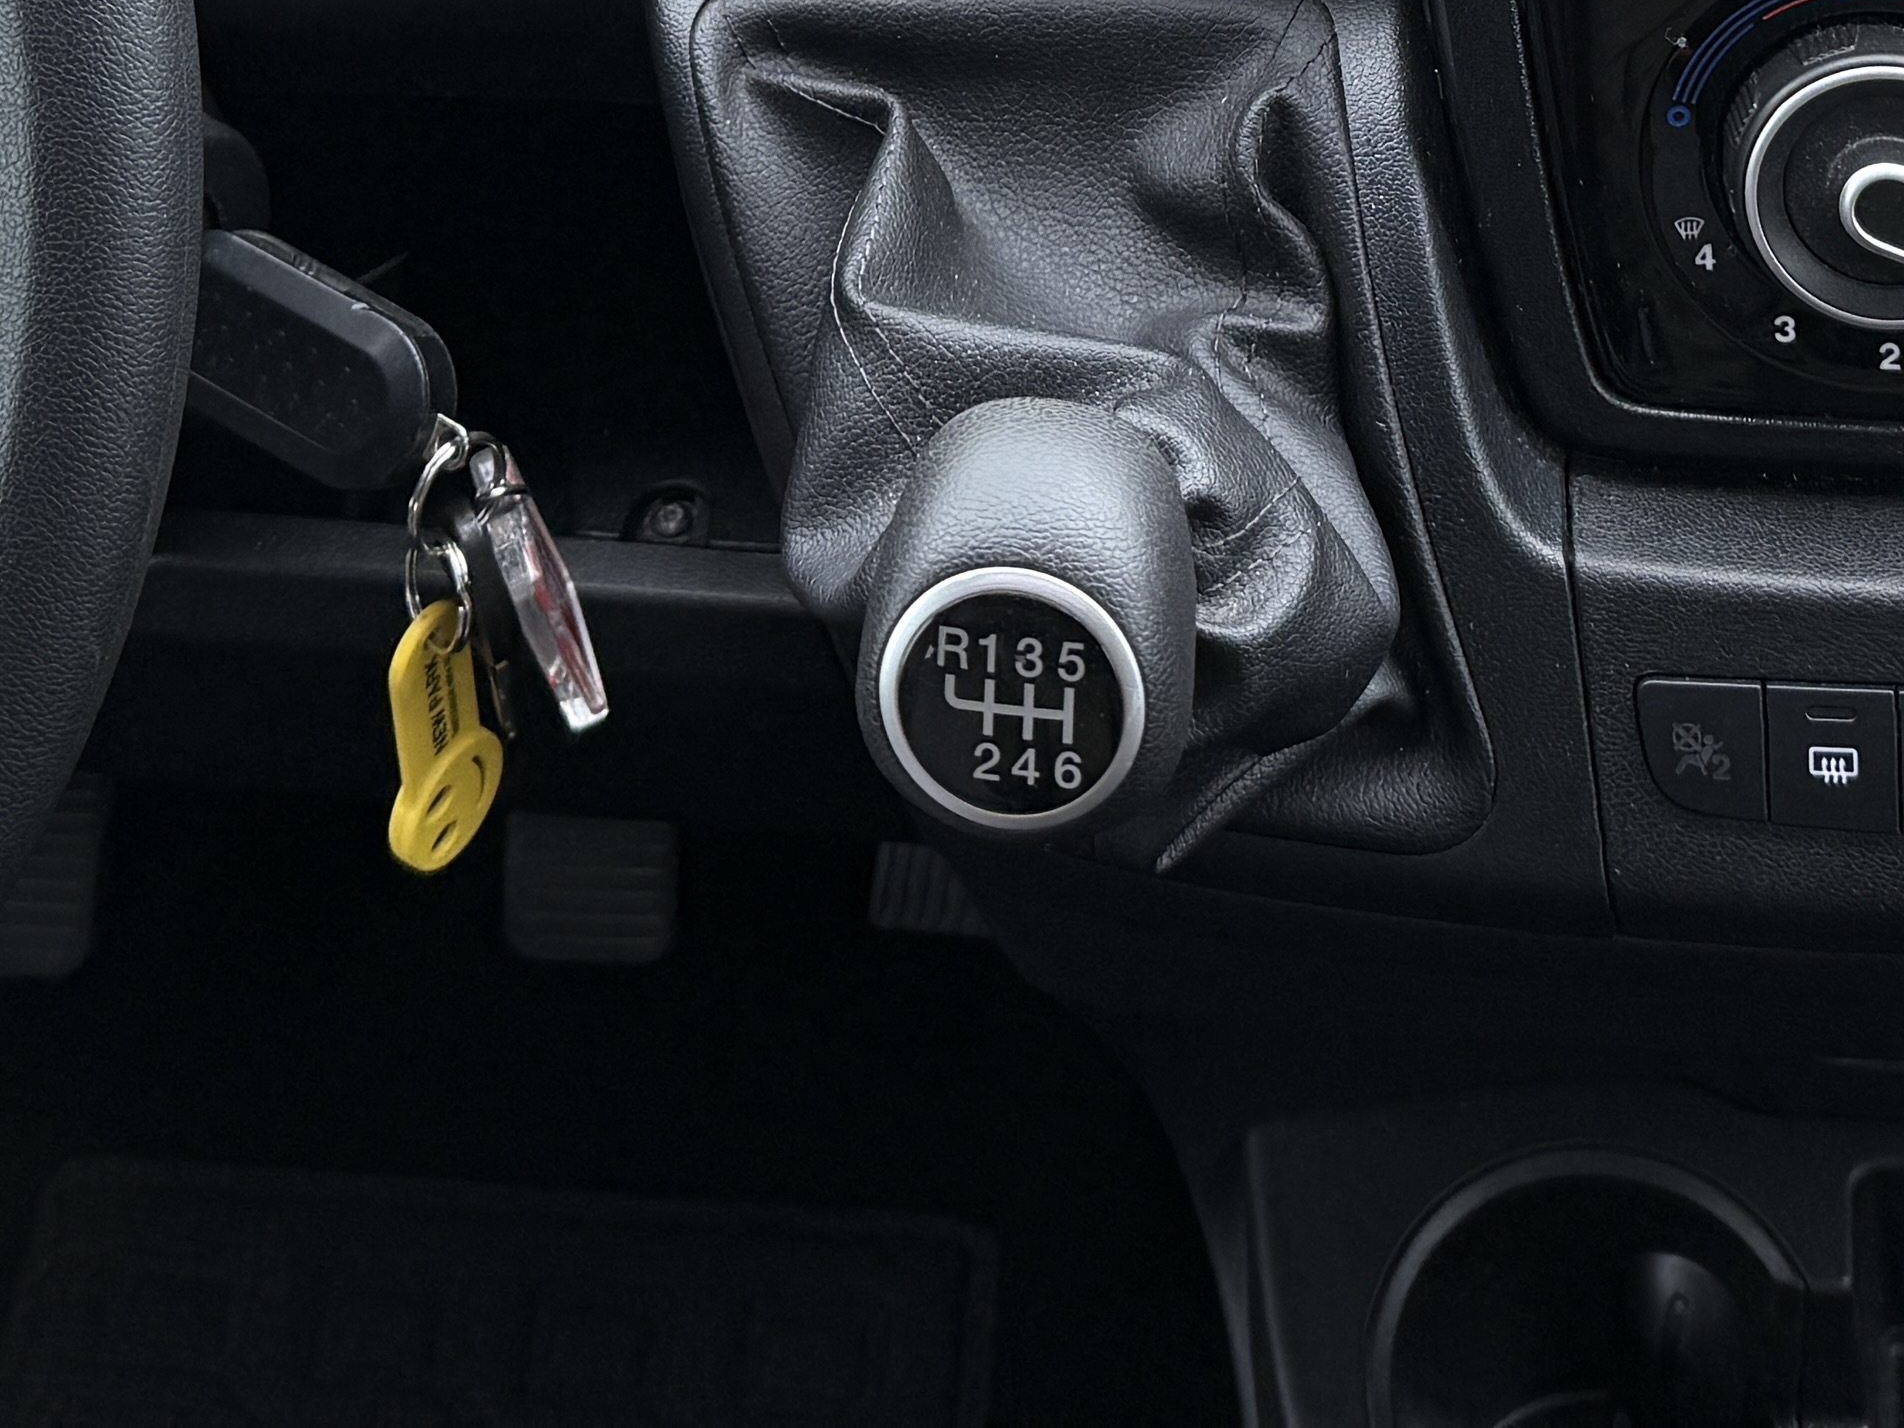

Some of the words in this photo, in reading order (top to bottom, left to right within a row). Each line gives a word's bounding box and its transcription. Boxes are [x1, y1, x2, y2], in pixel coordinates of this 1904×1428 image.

[1694, 243, 1717, 271] 4
[1773, 315, 1797, 343] 3
[1879, 342, 1902, 371] 2
